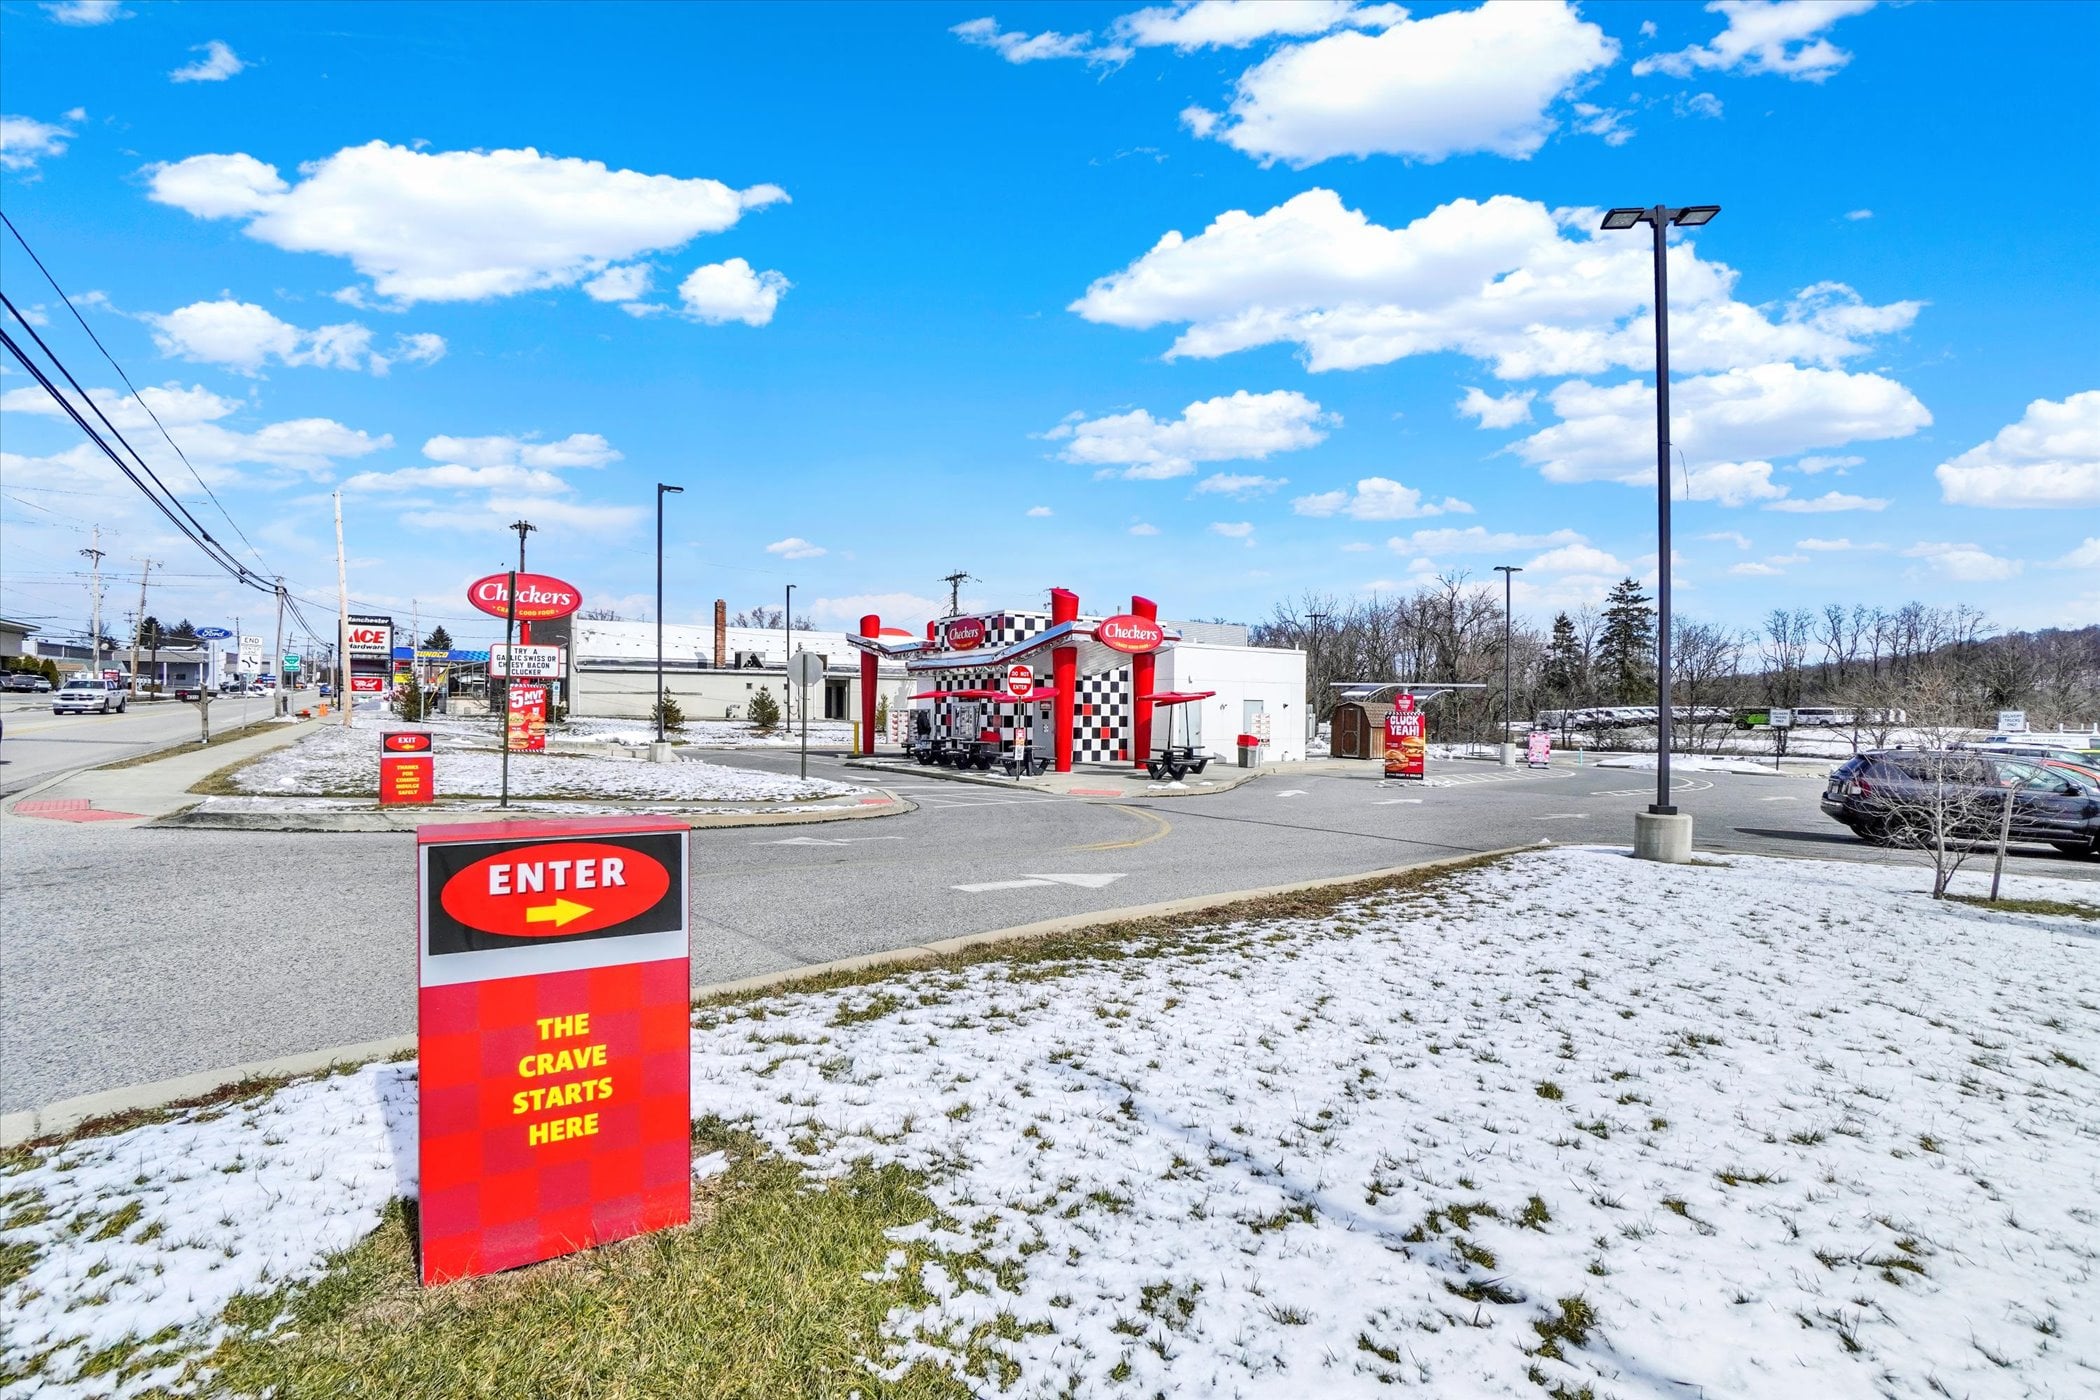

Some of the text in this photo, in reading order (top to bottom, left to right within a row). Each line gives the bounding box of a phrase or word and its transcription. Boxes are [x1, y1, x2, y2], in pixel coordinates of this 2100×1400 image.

[519, 609, 538, 617] GOOD
[348, 628, 386, 644] ACE
[949, 627, 979, 641] Checkers
[1104, 623, 1158, 641] Checkers
[496, 654, 522, 662] GALIC
[498, 661, 524, 669] CHESY
[524, 690, 544, 701] MVP
[1389, 715, 1420, 726] CLUCK
[1390, 725, 1420, 737] YEAH!
[489, 857, 625, 896] ENTER
[536, 1012, 590, 1041] THE
[518, 1044, 608, 1079] CRAVE
[513, 1077, 613, 1115] STARTS
[529, 1112, 599, 1147] HERE
